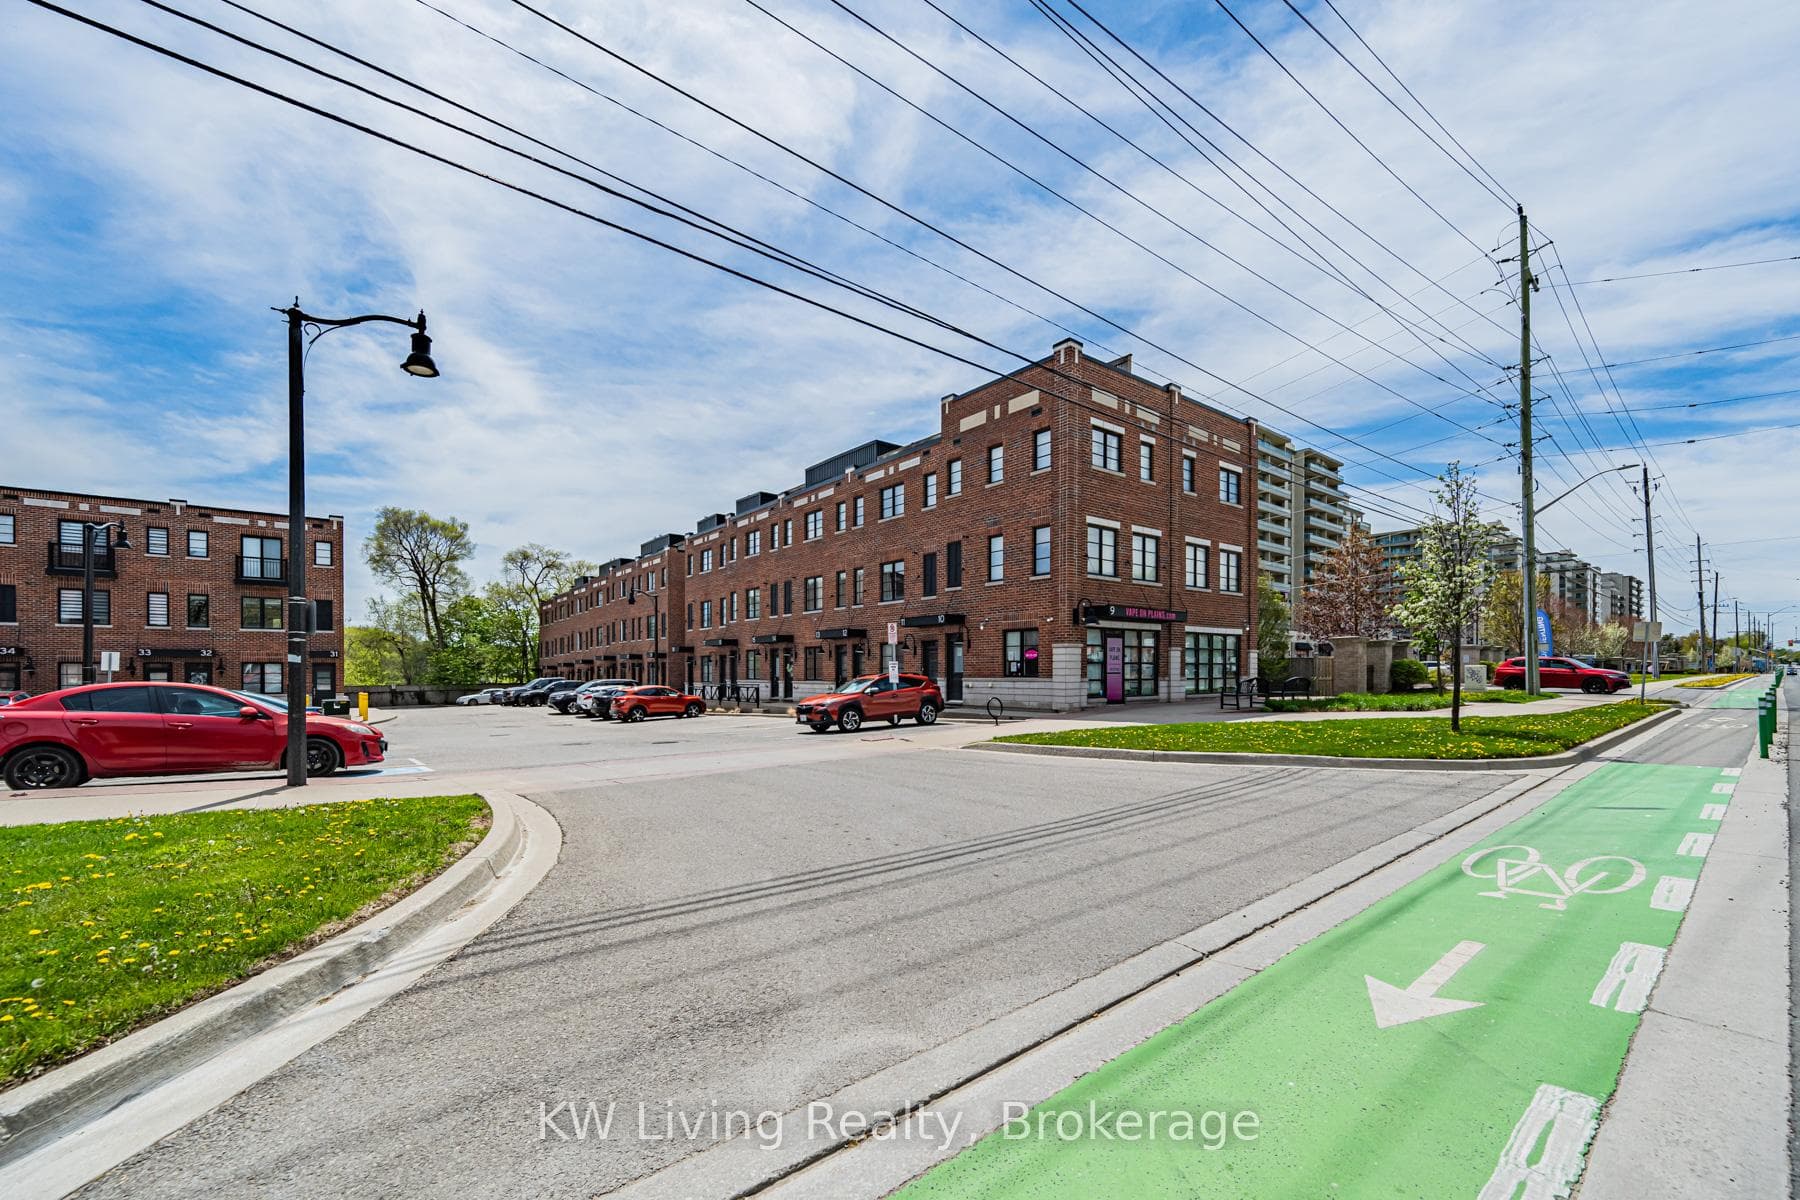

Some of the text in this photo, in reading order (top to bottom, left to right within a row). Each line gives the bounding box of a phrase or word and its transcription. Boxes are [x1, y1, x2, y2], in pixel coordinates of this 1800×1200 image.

[1109, 606, 1115, 615] 9
[1125, 607, 1138, 617] VAPE
[0, 647, 16, 655] 34
[138, 648, 152, 656] 33
[200, 649, 213, 657] 32
[330, 650, 339, 658] 31
